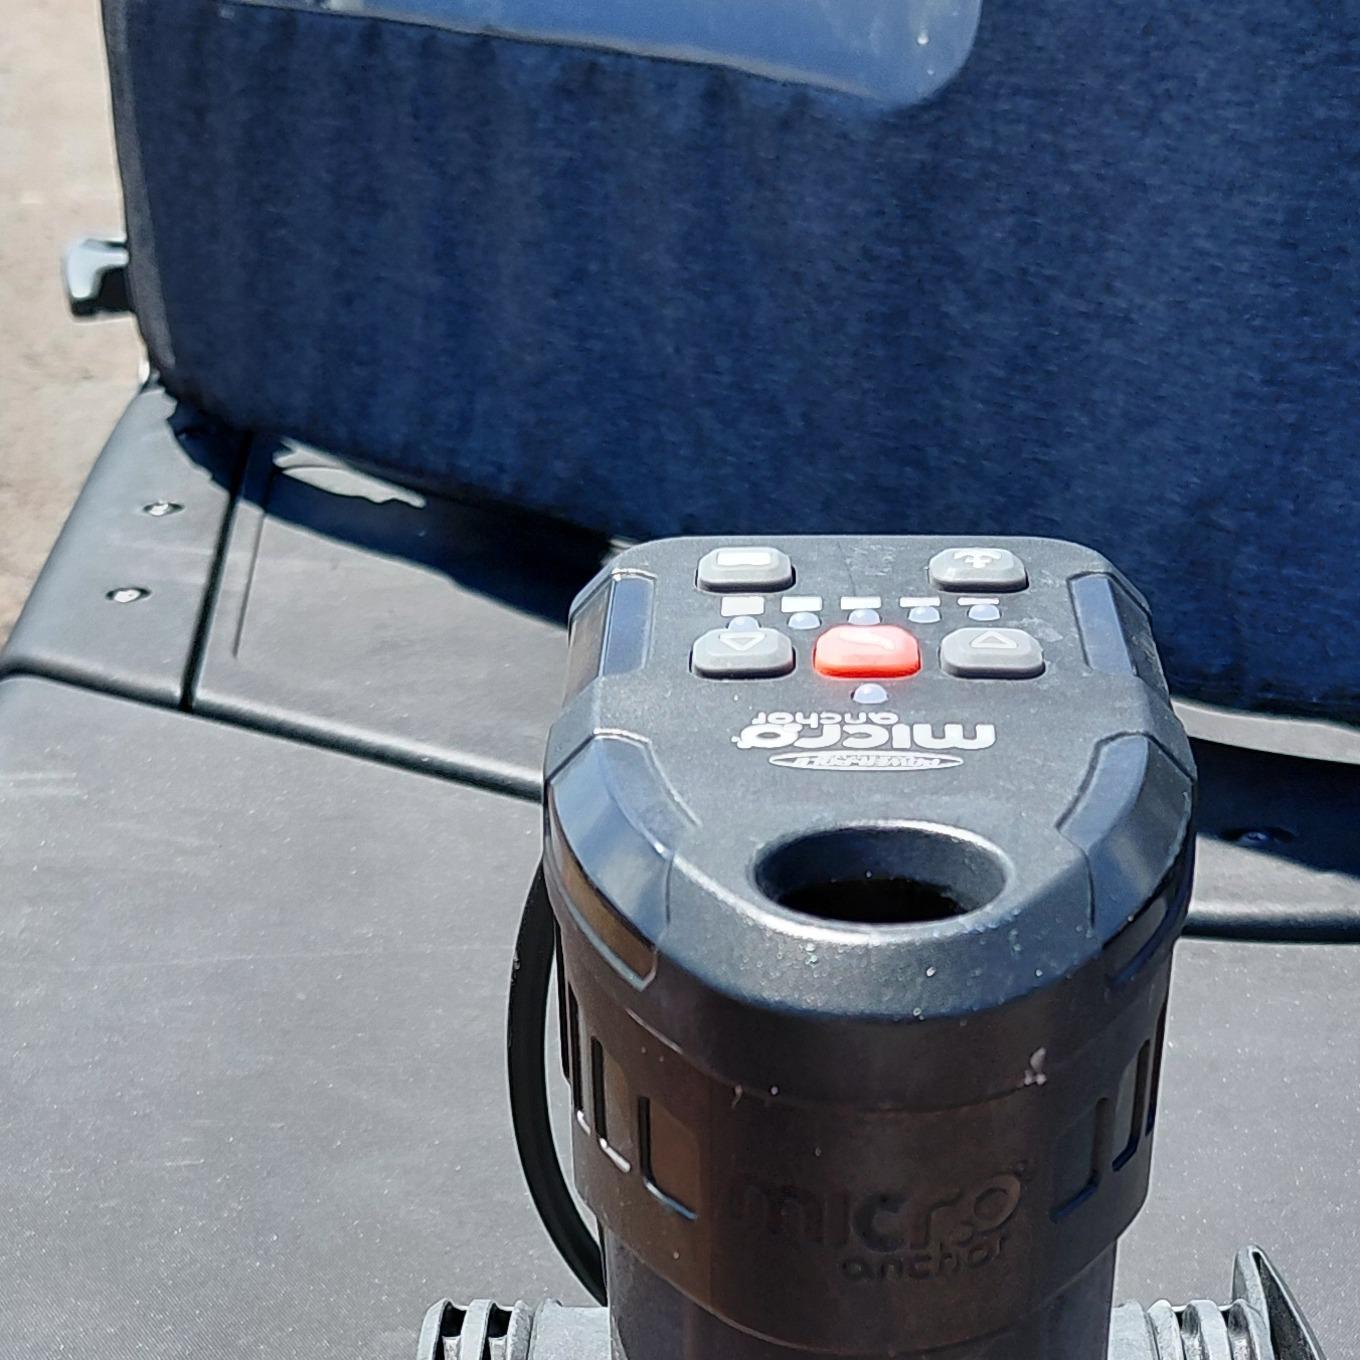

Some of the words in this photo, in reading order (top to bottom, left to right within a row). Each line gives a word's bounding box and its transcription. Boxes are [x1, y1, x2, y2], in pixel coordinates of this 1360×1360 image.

[731, 723, 995, 750] micro
[752, 711, 900, 728] anchor
[728, 1174, 1023, 1252] micro
[841, 1232, 1008, 1281] anchor
